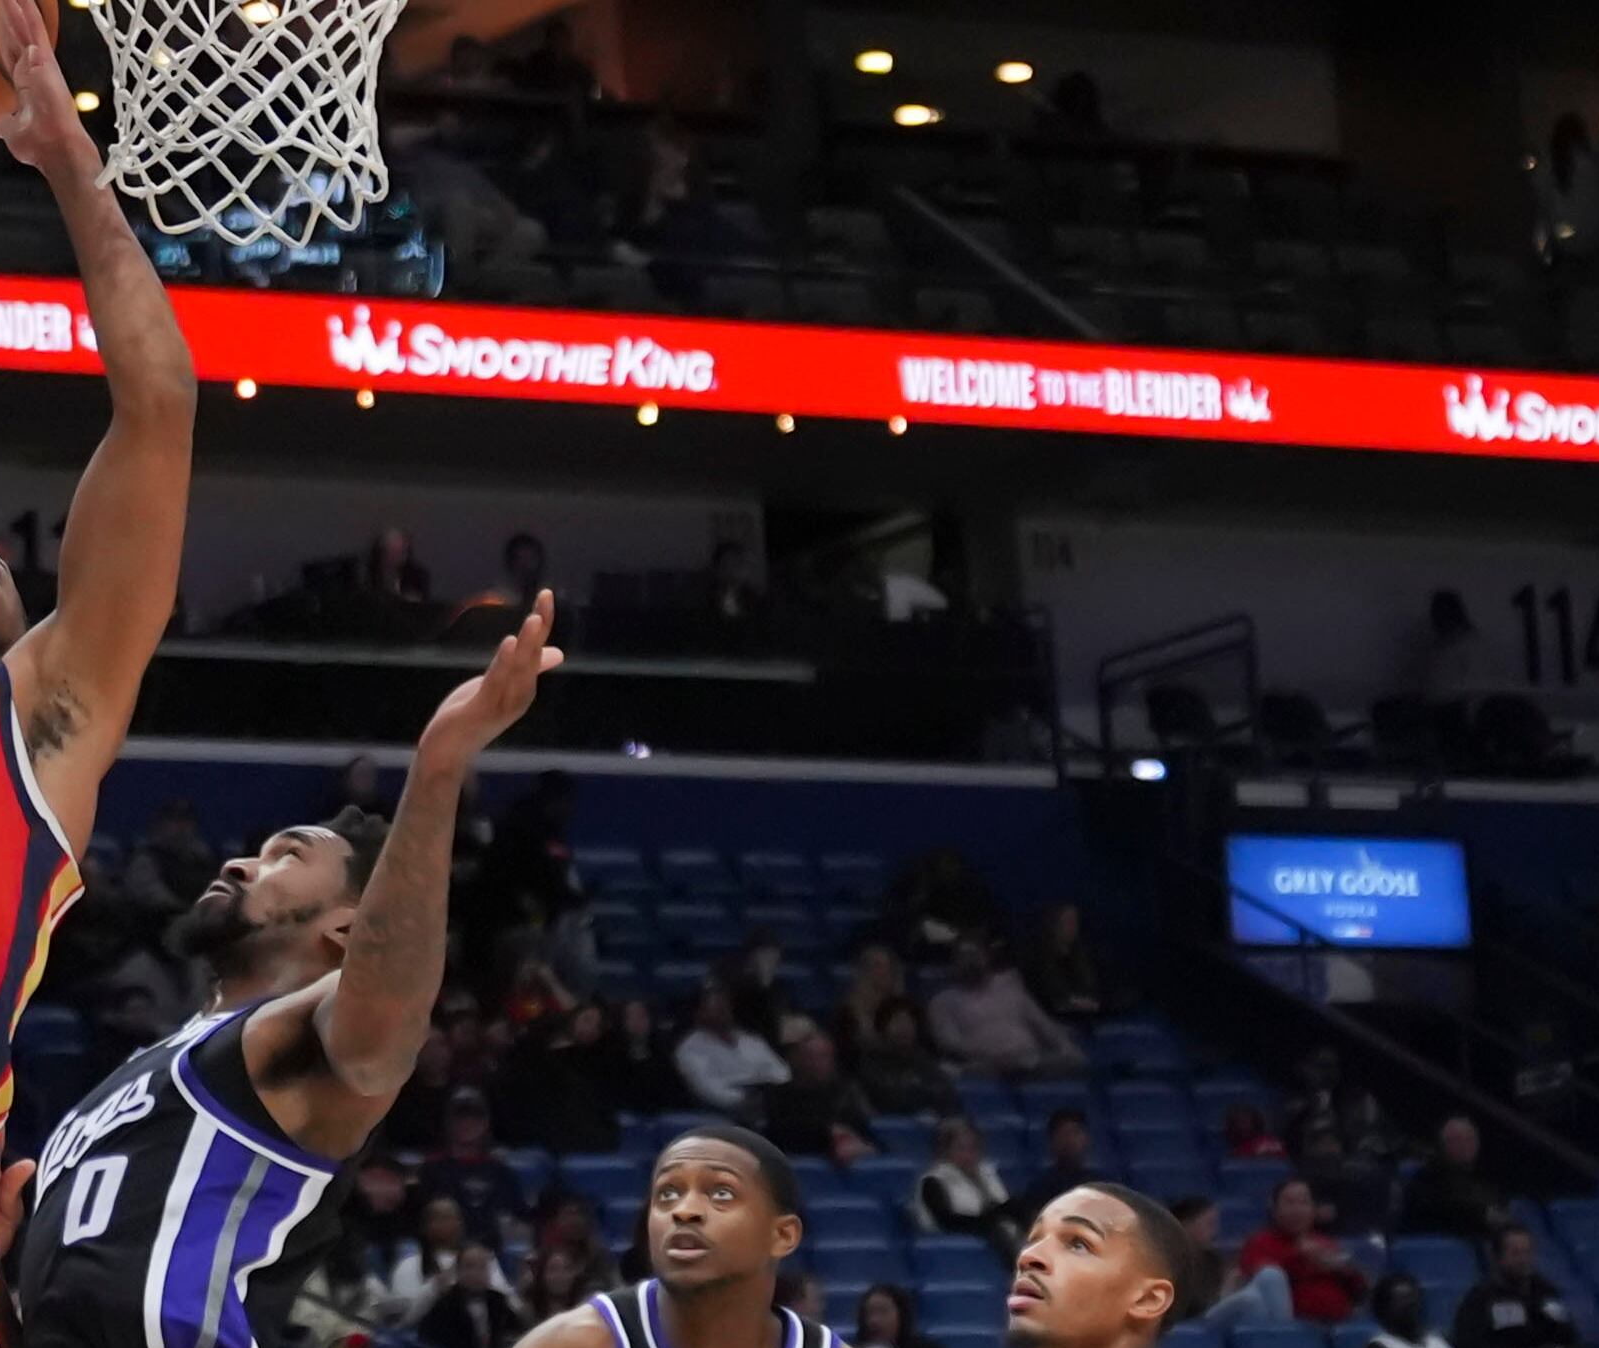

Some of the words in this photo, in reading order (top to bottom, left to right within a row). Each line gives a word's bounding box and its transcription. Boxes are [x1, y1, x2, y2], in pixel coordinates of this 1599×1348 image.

[408, 322, 613, 386] SMOOTHIE
[613, 335, 715, 393] KING
[899, 355, 1037, 411] WELCOME
[1040, 369, 1066, 406] TO
[1066, 370, 1102, 408] THE
[1102, 366, 1222, 421] BLENDER
[63, 1154, 129, 1246] 0
